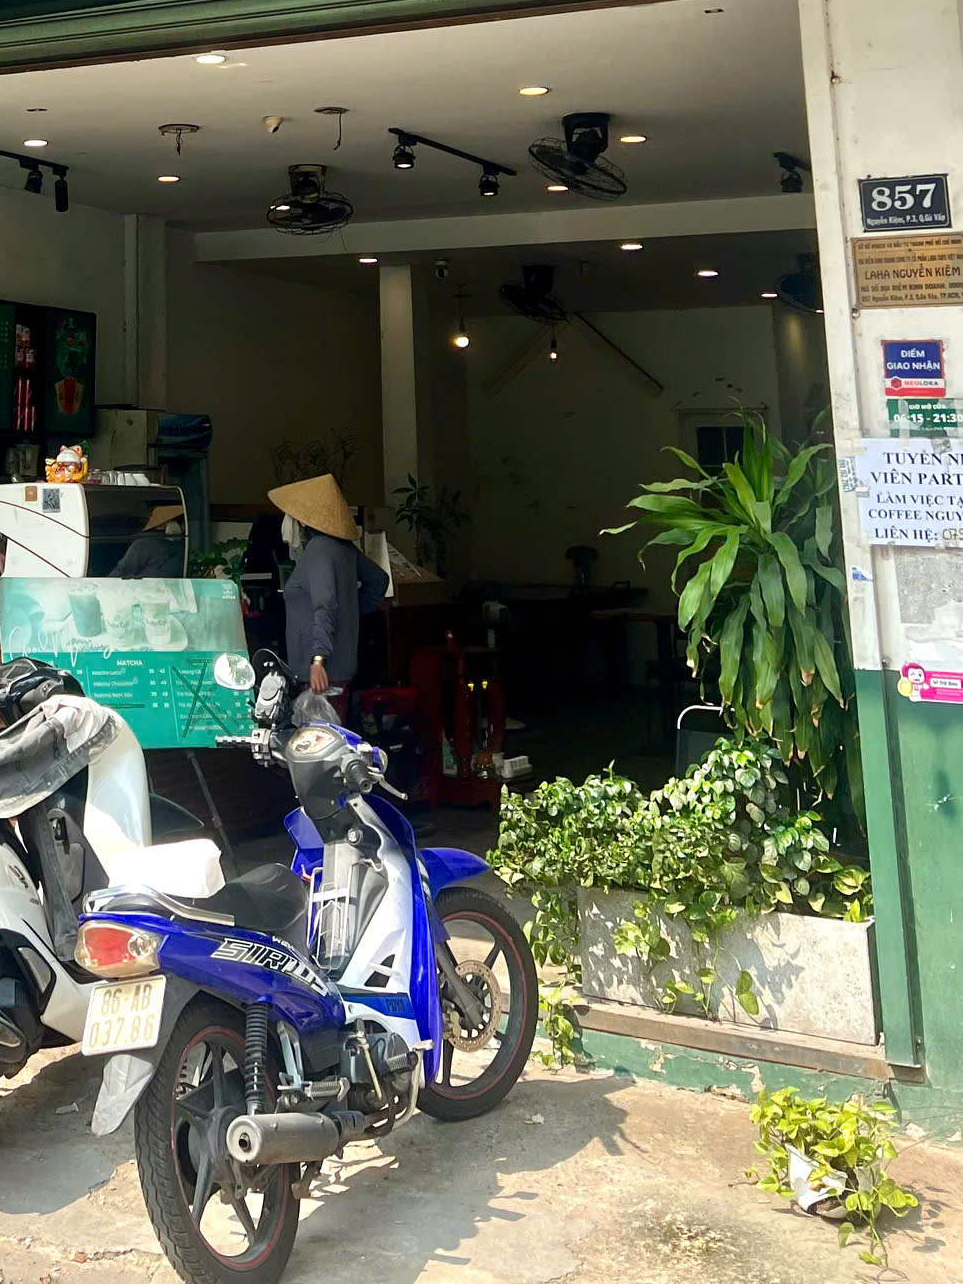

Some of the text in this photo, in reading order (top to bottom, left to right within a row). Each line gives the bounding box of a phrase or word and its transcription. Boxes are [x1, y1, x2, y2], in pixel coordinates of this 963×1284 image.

[871, 183, 936, 211] 857
[865, 269, 890, 280] LAHA
[886, 359, 941, 372] GIAO NHẬN
[870, 468, 912, 485] VIÊN
[876, 491, 907, 505] LÀM
[868, 508, 923, 520] COFFEE
[874, 525, 939, 543] LIÊN HỆ:
[116, 659, 143, 667] MATCHA
